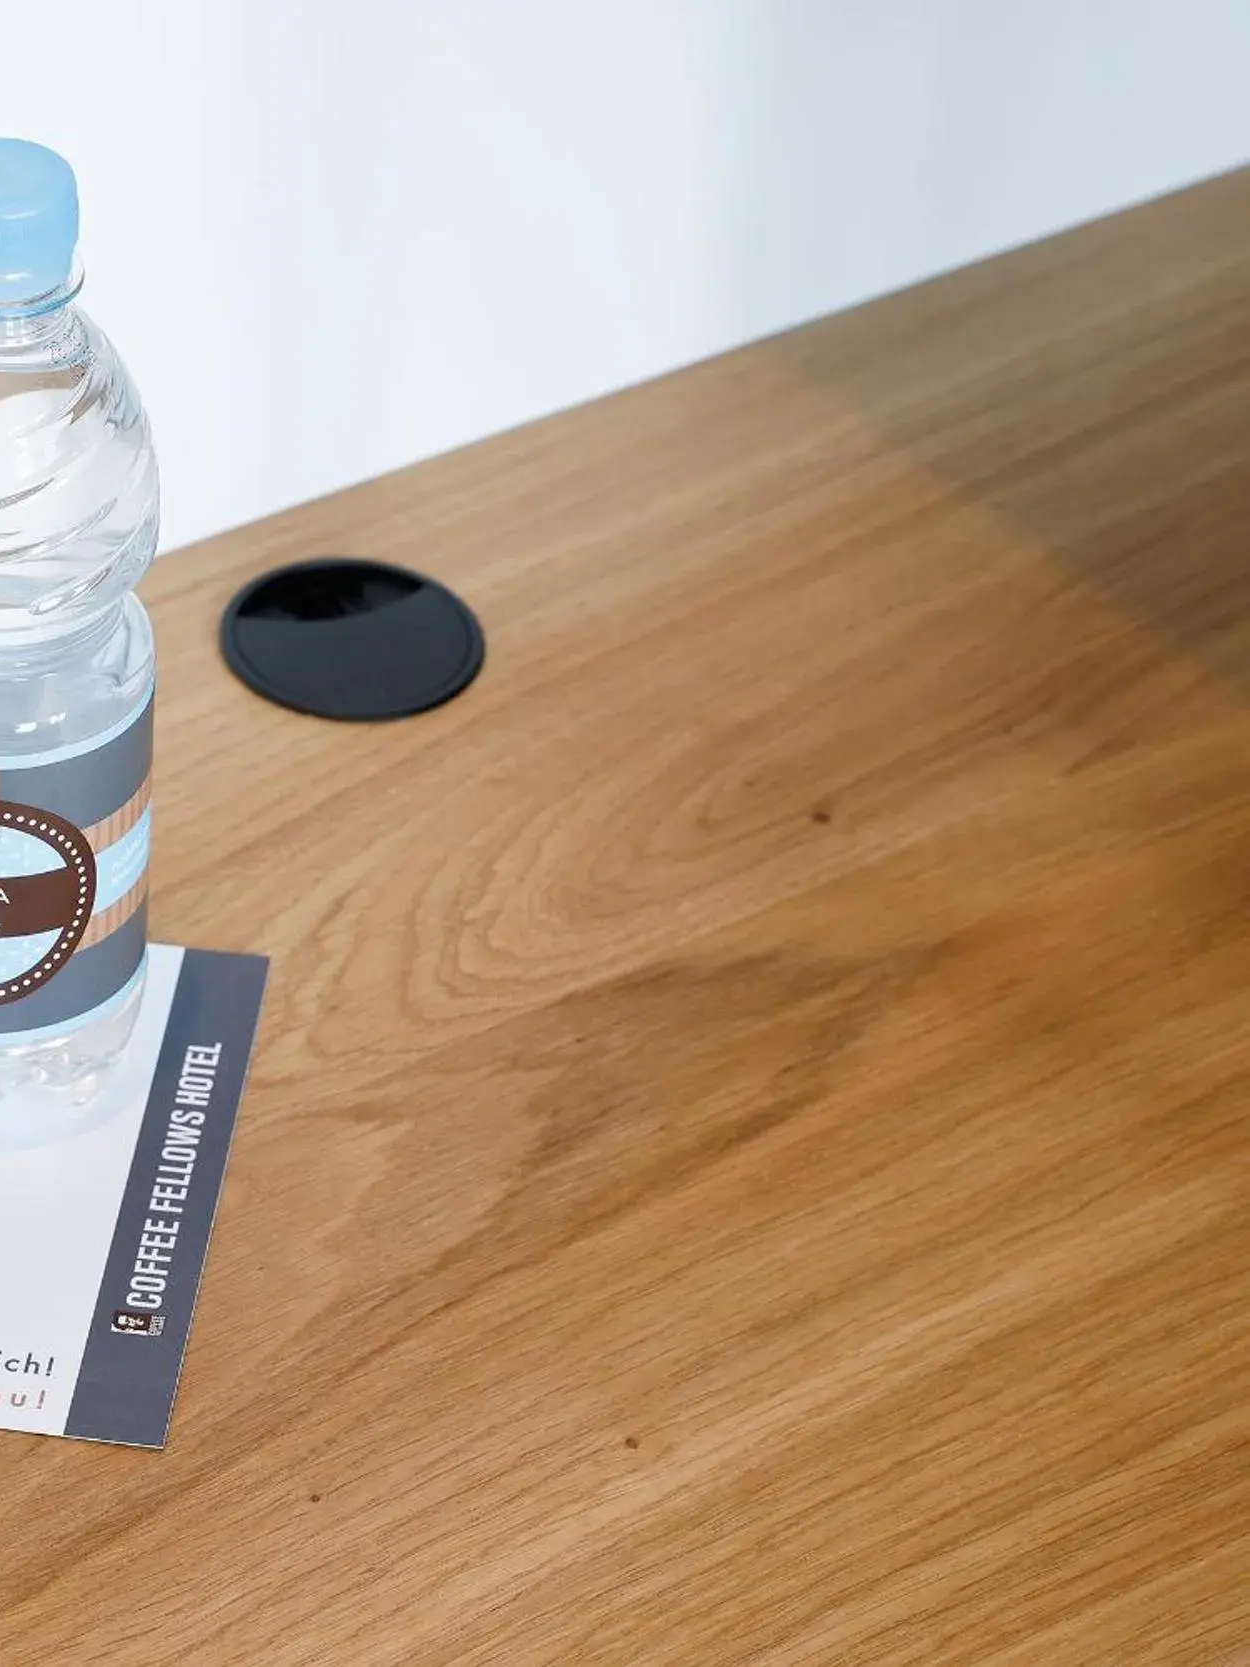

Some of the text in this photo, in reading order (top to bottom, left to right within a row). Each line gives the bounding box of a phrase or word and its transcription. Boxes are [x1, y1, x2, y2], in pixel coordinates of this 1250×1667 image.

[126, 1042, 222, 1310] COFFEE FELLOWS HOTEL
